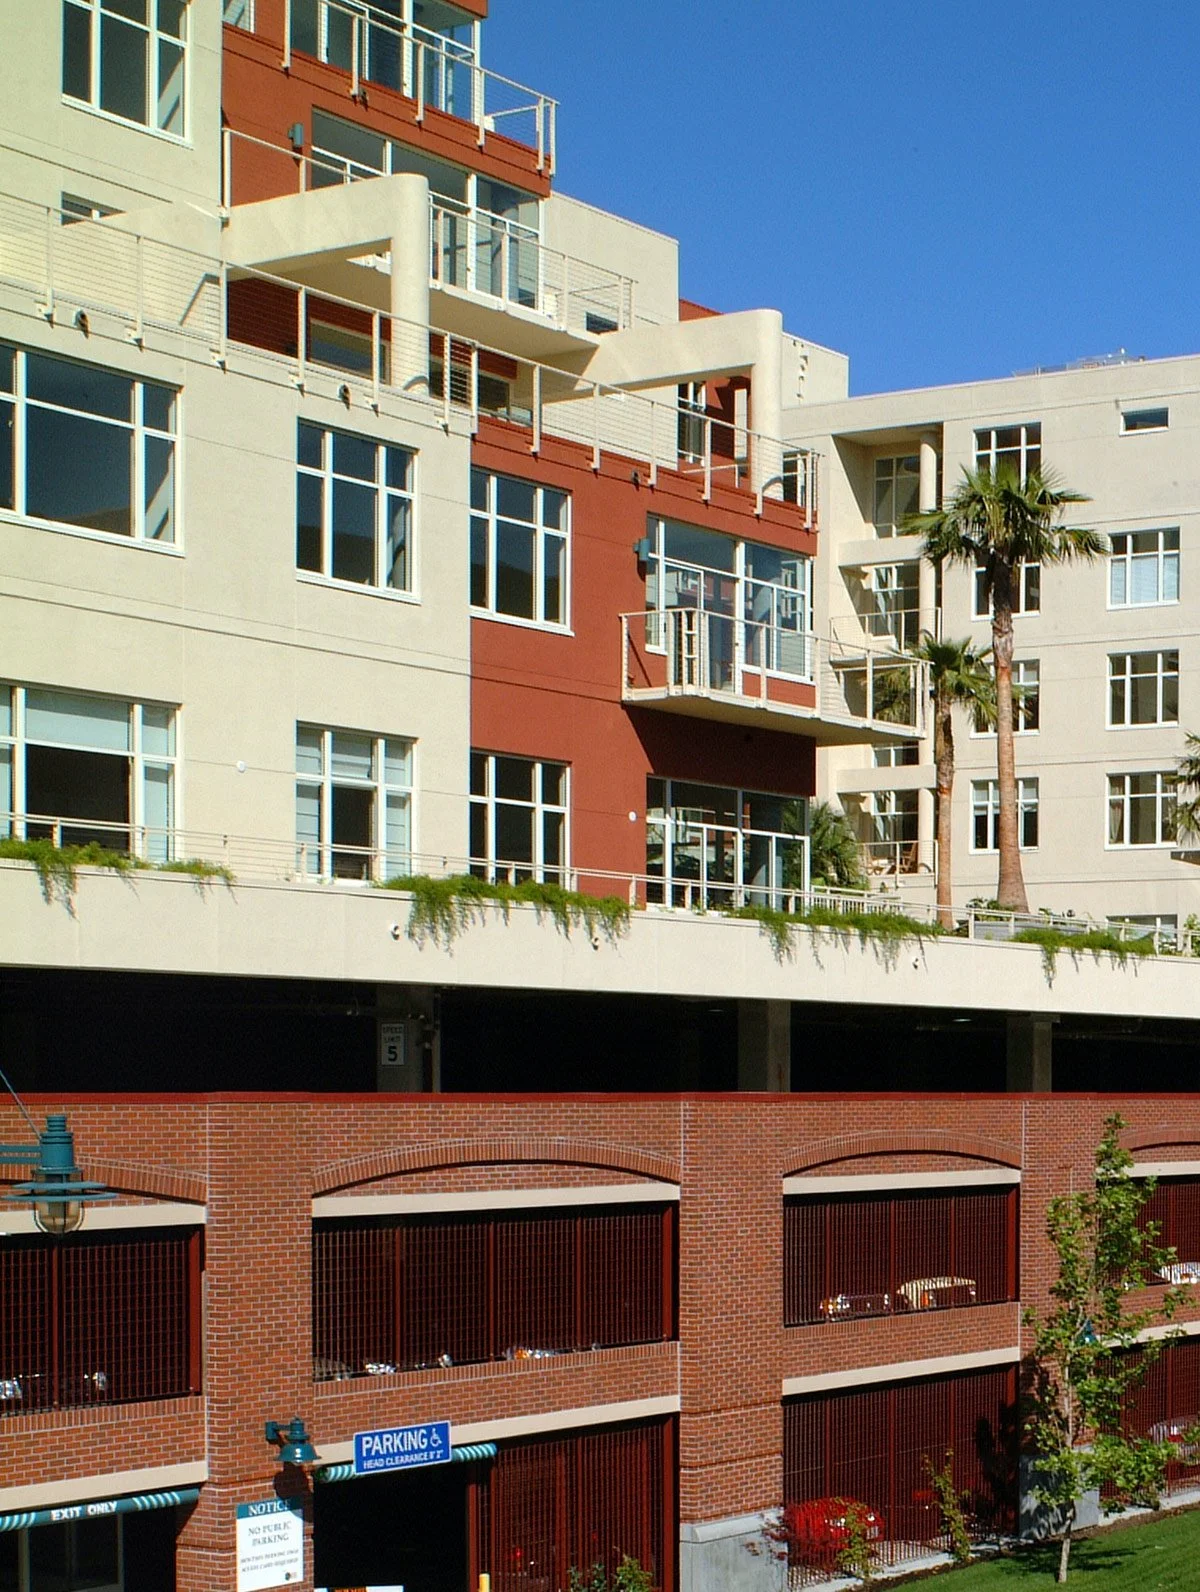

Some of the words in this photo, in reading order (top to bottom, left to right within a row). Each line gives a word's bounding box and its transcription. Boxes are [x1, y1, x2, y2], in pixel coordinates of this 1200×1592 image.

[387, 1046, 397, 1062] 5
[362, 1428, 428, 1457] PARKING
[363, 1459, 384, 1470] HEAD
[385, 1452, 428, 1466] CLEARANCE
[51, 1507, 82, 1521] EXIT
[86, 1501, 117, 1515] ONLY
[248, 1526, 260, 1536] NO
[262, 1521, 291, 1533] PUBLIC
[252, 1533, 289, 1546] PARKING
